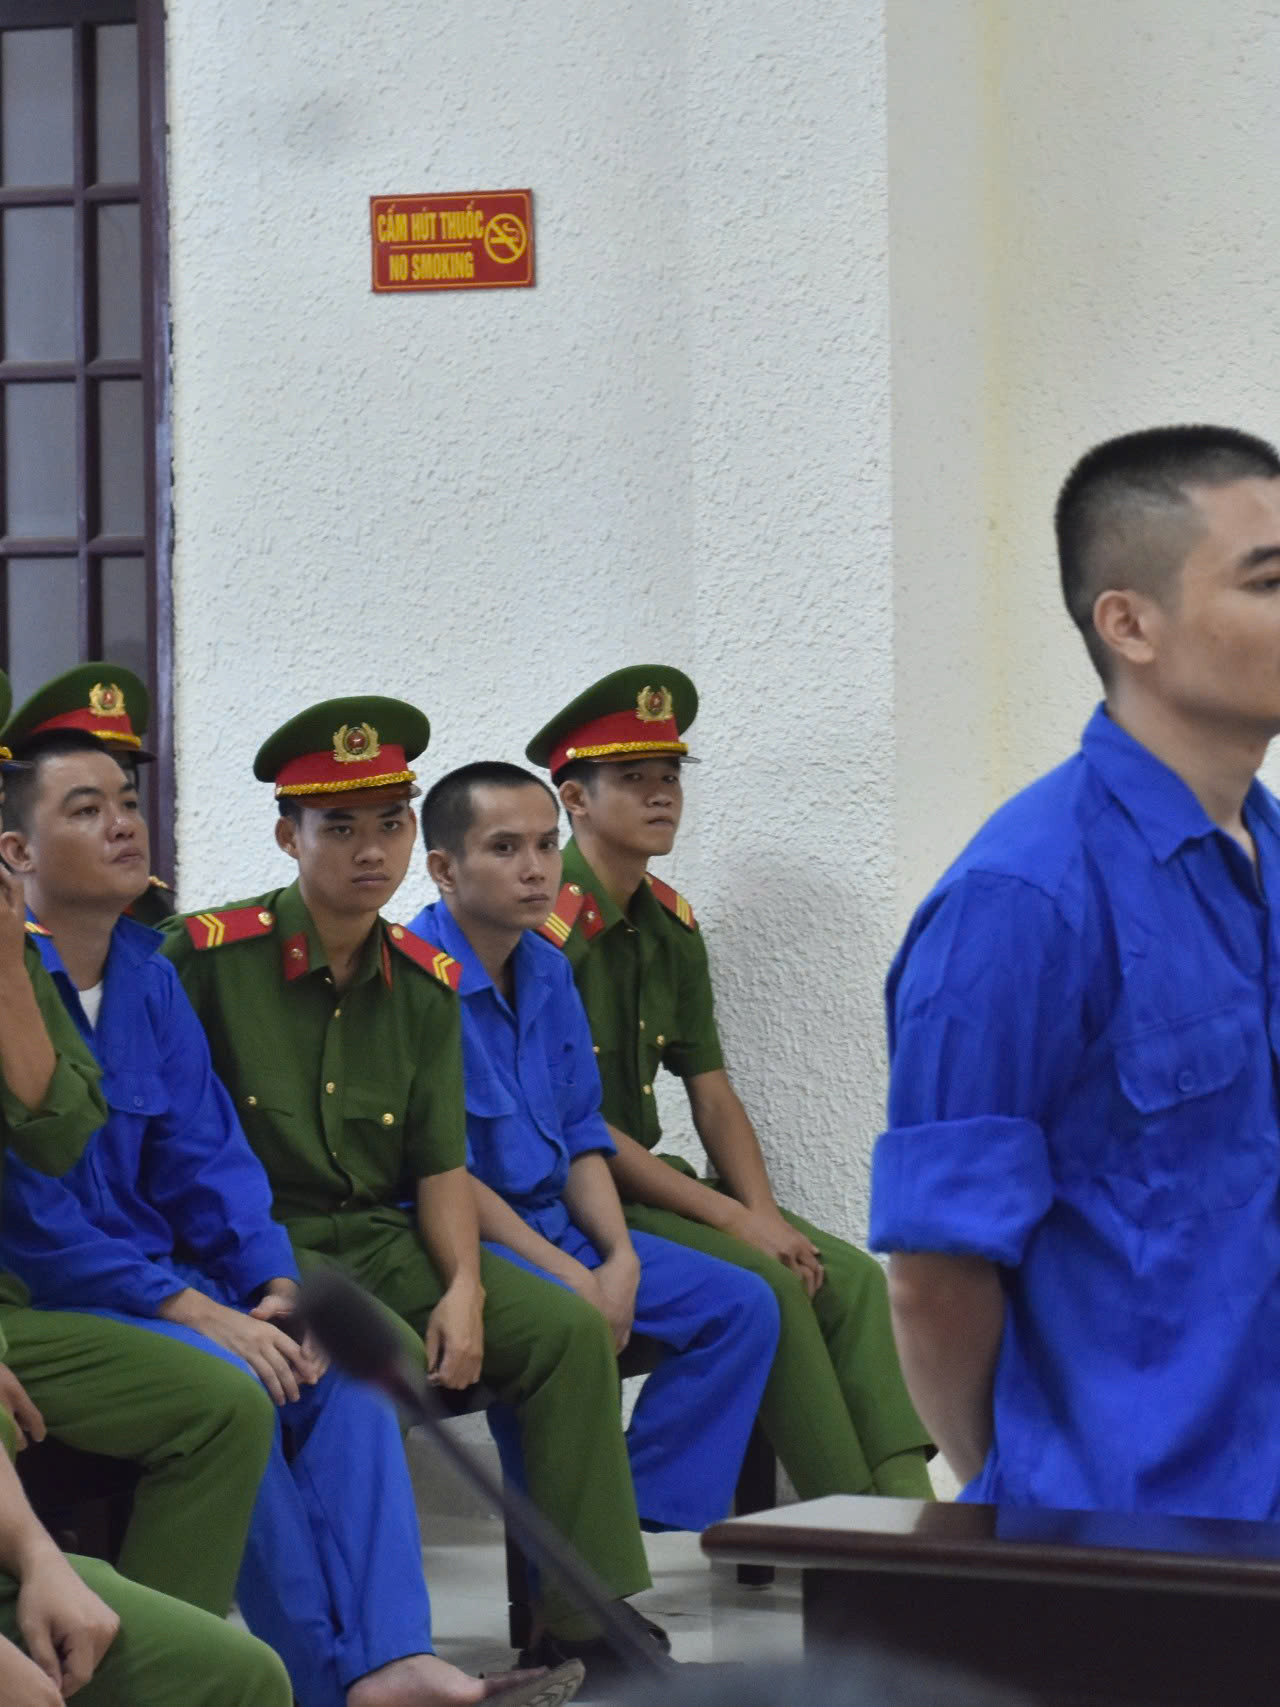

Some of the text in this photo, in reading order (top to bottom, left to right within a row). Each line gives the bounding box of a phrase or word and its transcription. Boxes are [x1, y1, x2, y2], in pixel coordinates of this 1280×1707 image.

[377, 201, 484, 243] CẤM HÚT THUỐC
[389, 252, 475, 281] NO SMOKING
